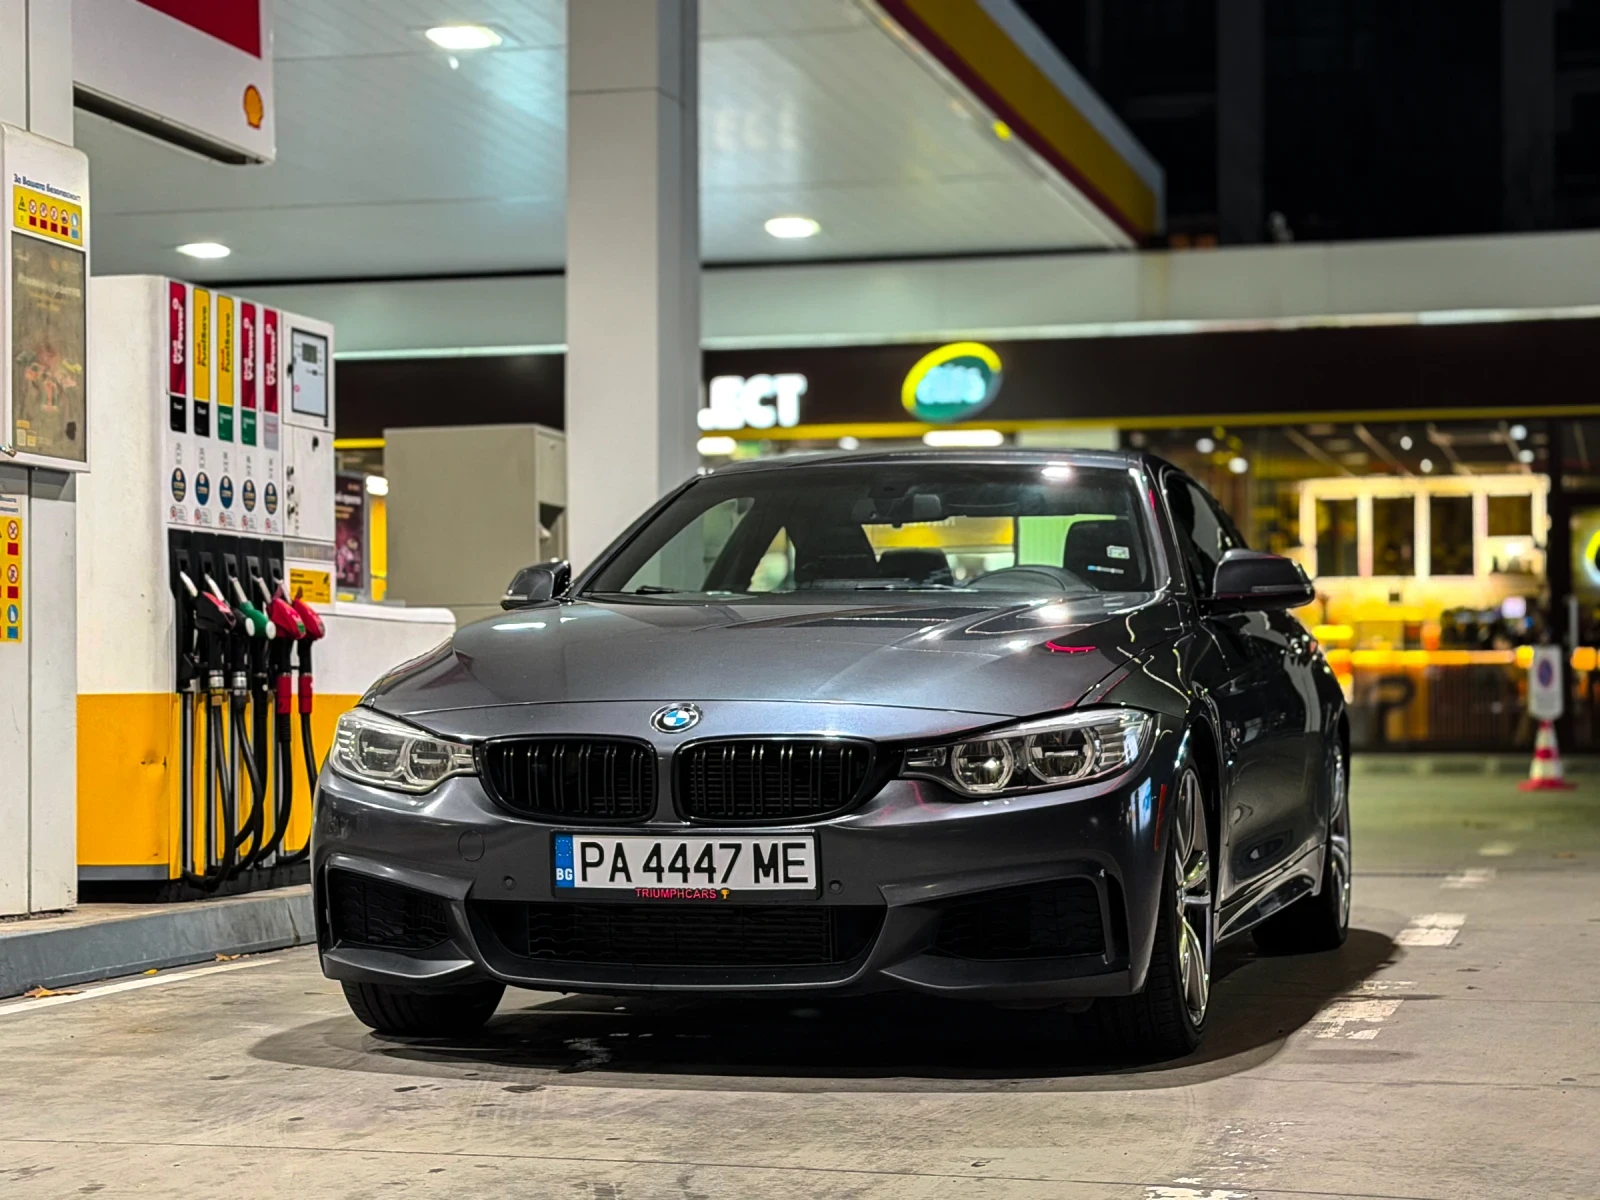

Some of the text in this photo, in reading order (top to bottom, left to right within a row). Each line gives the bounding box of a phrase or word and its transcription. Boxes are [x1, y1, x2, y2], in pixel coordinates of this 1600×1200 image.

[697, 373, 808, 431] ECT
[555, 867, 573, 881] BG
[579, 841, 809, 884] PA 4447 ME
